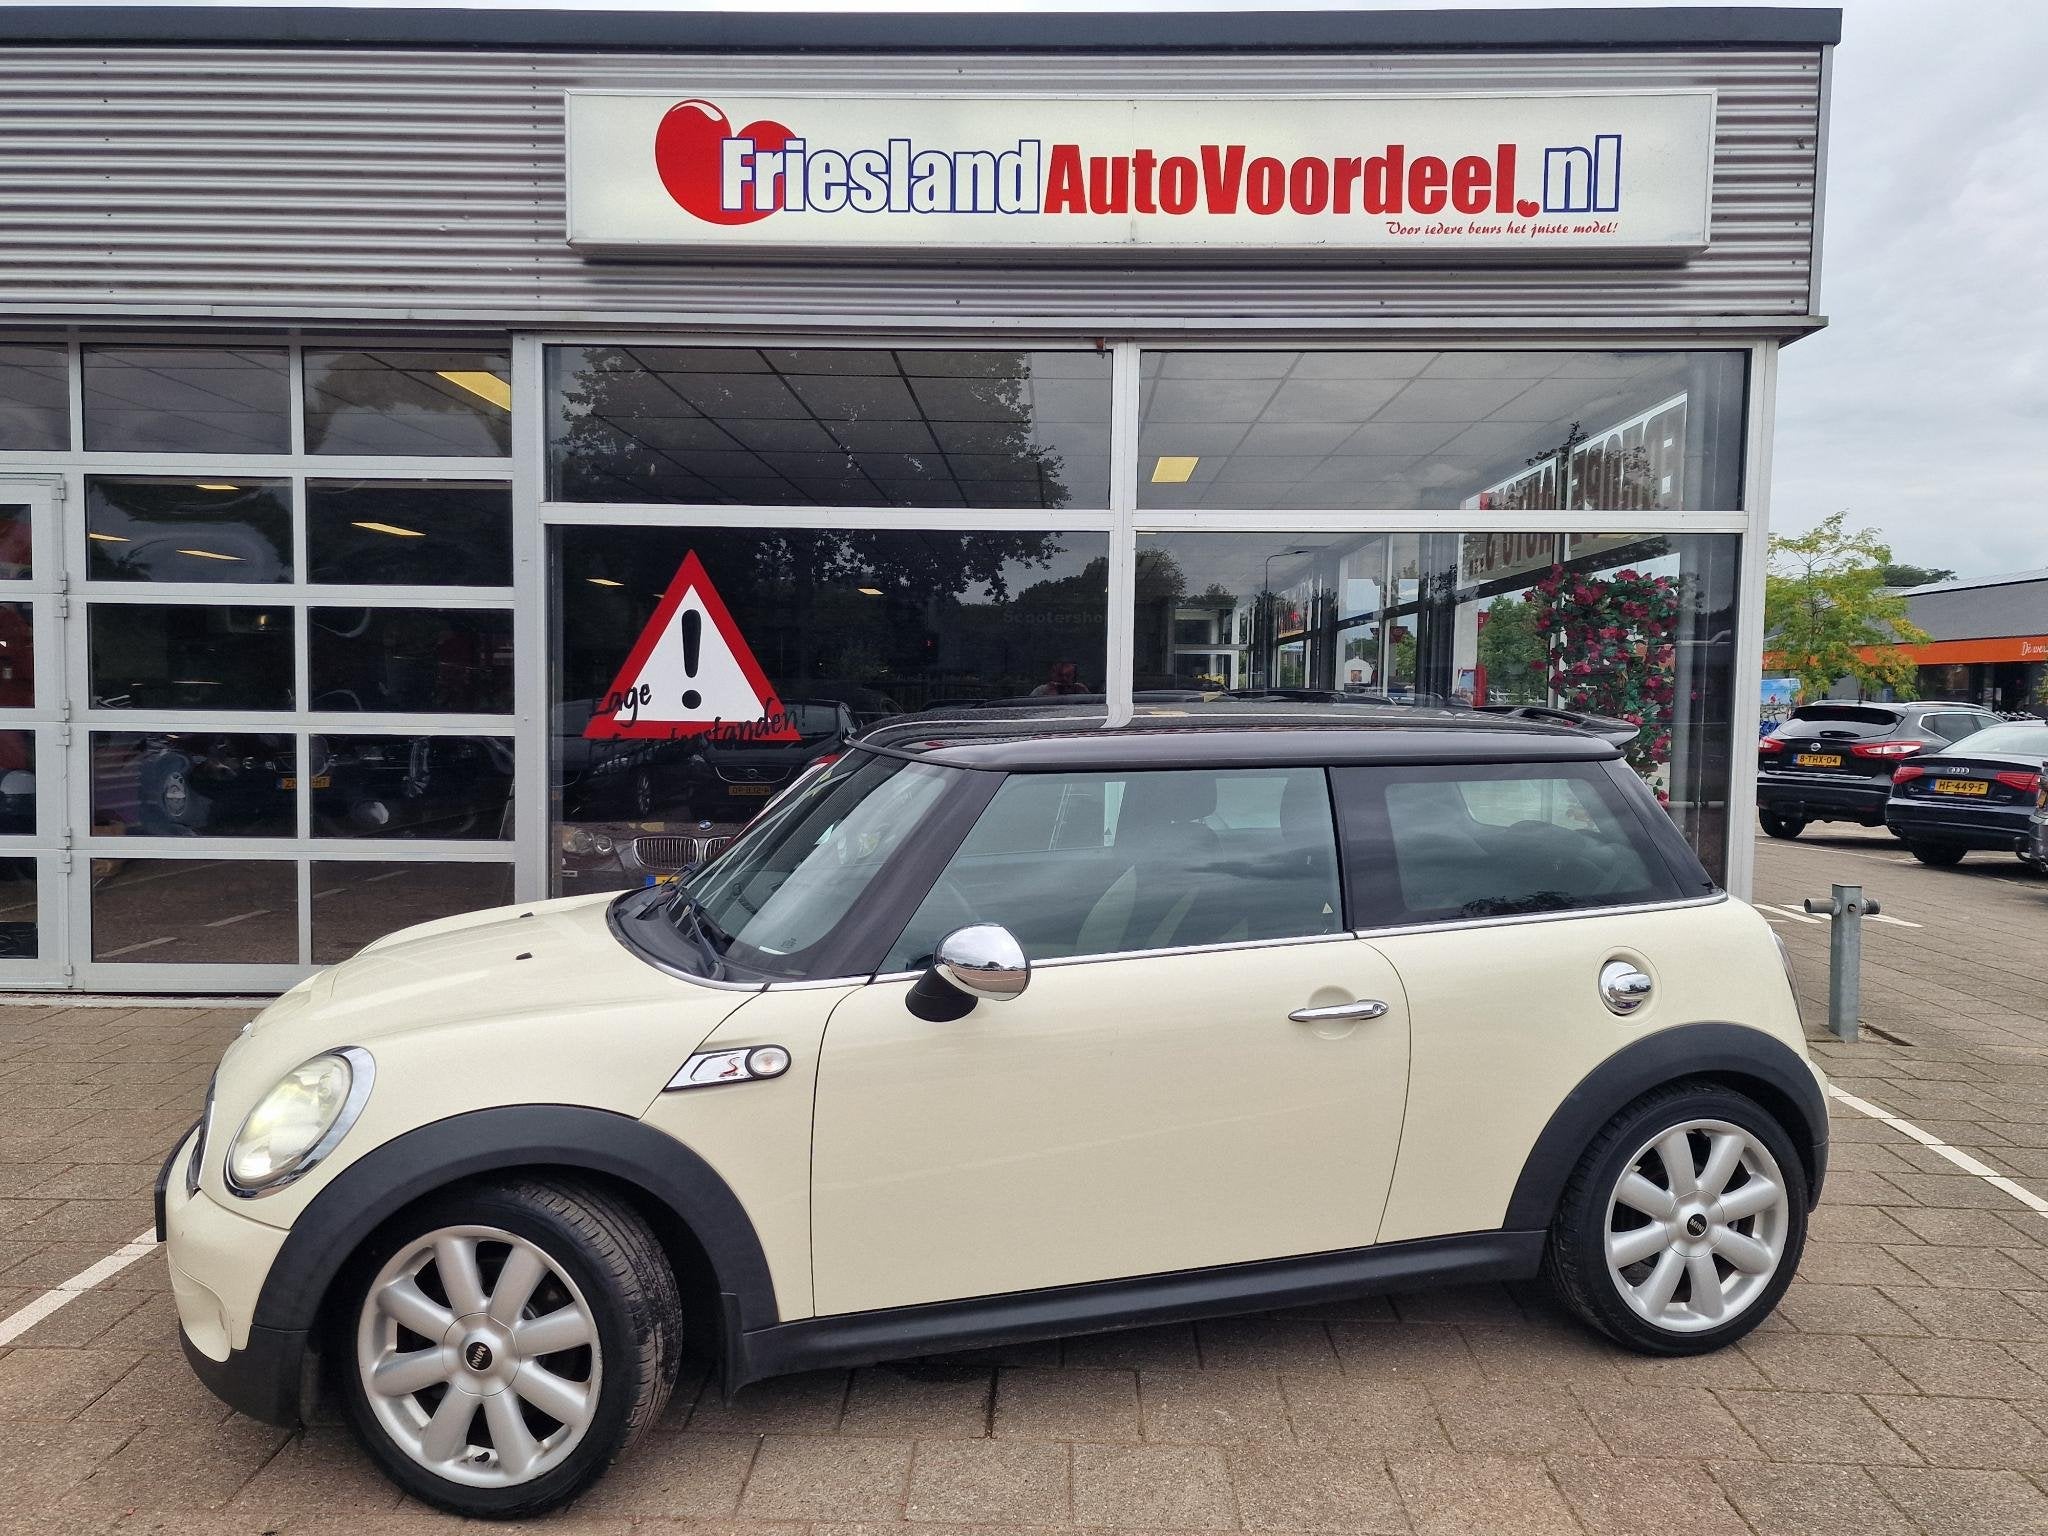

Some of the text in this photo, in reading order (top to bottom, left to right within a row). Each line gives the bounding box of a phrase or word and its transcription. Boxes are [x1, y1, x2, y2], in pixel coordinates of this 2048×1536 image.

[720, 134, 1622, 218] FrieslandAutoVoordeel.nl
[1385, 221, 1618, 238] Voor iedere beurs het juiste model!
[589, 681, 653, 728] Lage
[1799, 755, 1838, 764] 8-THX-04
[1938, 781, 1986, 793] HF-449-F
[472, 1345, 486, 1368] MINI
